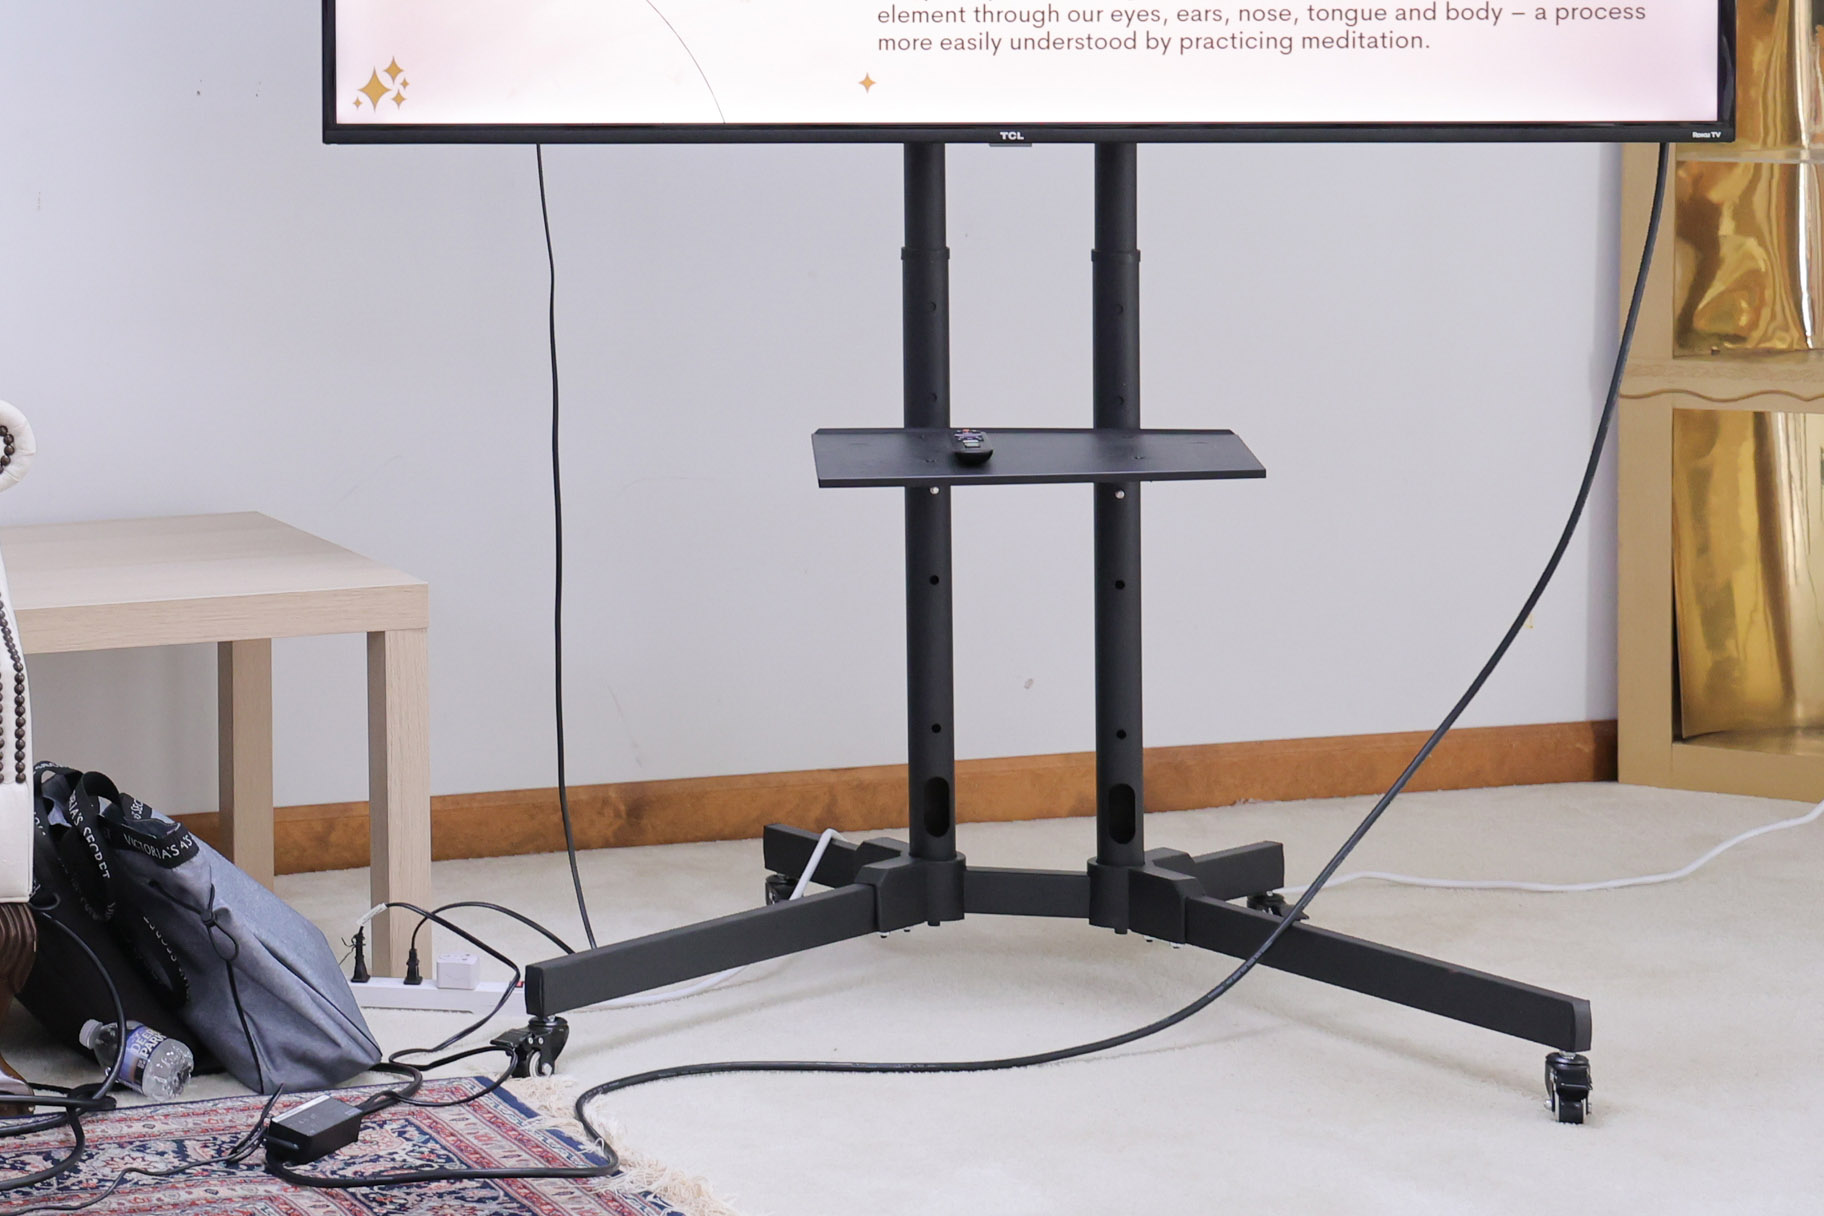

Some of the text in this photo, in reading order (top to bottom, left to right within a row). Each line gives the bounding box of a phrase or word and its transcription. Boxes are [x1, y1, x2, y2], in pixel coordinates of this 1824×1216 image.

[877, 3, 967, 24] element
[972, 2, 1060, 30] through
[1066, 9, 1105, 23] our
[1109, 8, 1169, 29] eyes,
[1176, 8, 1230, 27] ears,
[1238, 7, 1299, 26] nose,
[1306, 4, 1388, 28] tongue
[1394, 0, 1437, 22] and
[1445, 0, 1504, 27] body
[1534, 6, 1548, 21] a
[1555, 6, 1647, 27] process
[877, 28, 1431, 57] more easily understood by practicing meditation.
[1000, 131, 1024, 140] TCL
[123, 833, 180, 860] VICTORIA'S
[140, 1031, 168, 1060] PARK
